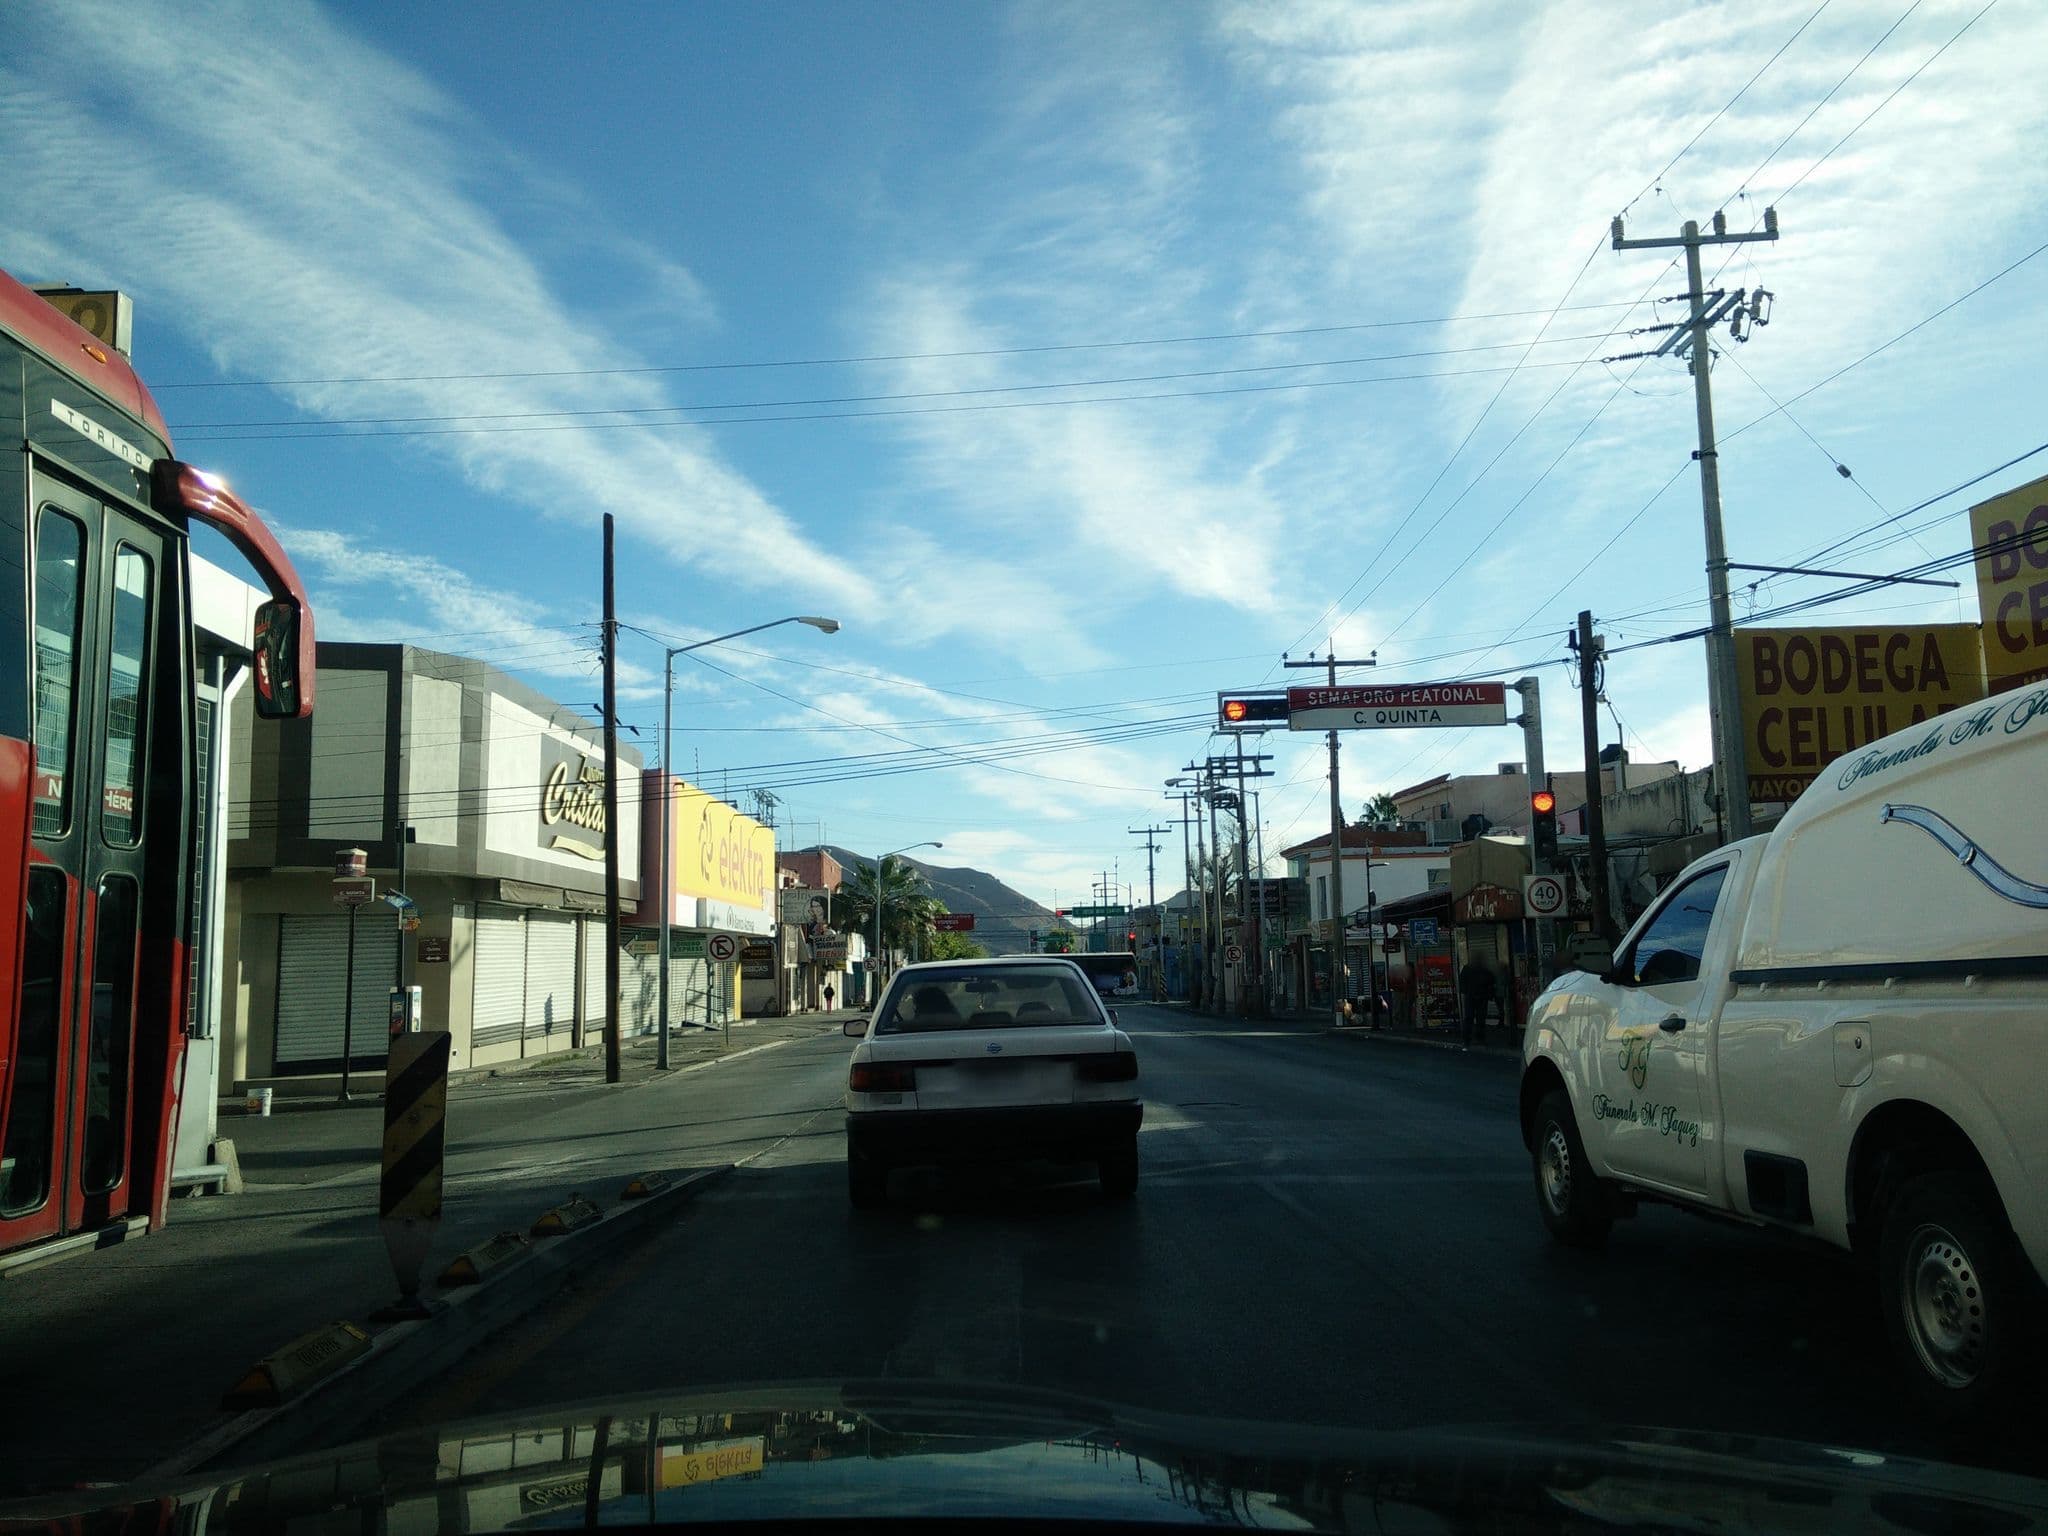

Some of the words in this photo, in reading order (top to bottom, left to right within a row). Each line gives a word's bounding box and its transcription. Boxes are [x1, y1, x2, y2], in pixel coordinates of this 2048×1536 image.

[67, 411, 143, 464] TORINO
[1753, 633, 1951, 695] BODEGA
[1308, 690, 1394, 705] SEMAFORO
[1401, 687, 1485, 703] PEATONAL
[1354, 711, 1367, 724] C.
[1376, 709, 1441, 723] QUINTA
[1838, 724, 1944, 790] Funerales
[719, 823, 764, 896] elektra
[1535, 886, 1555, 899] 40
